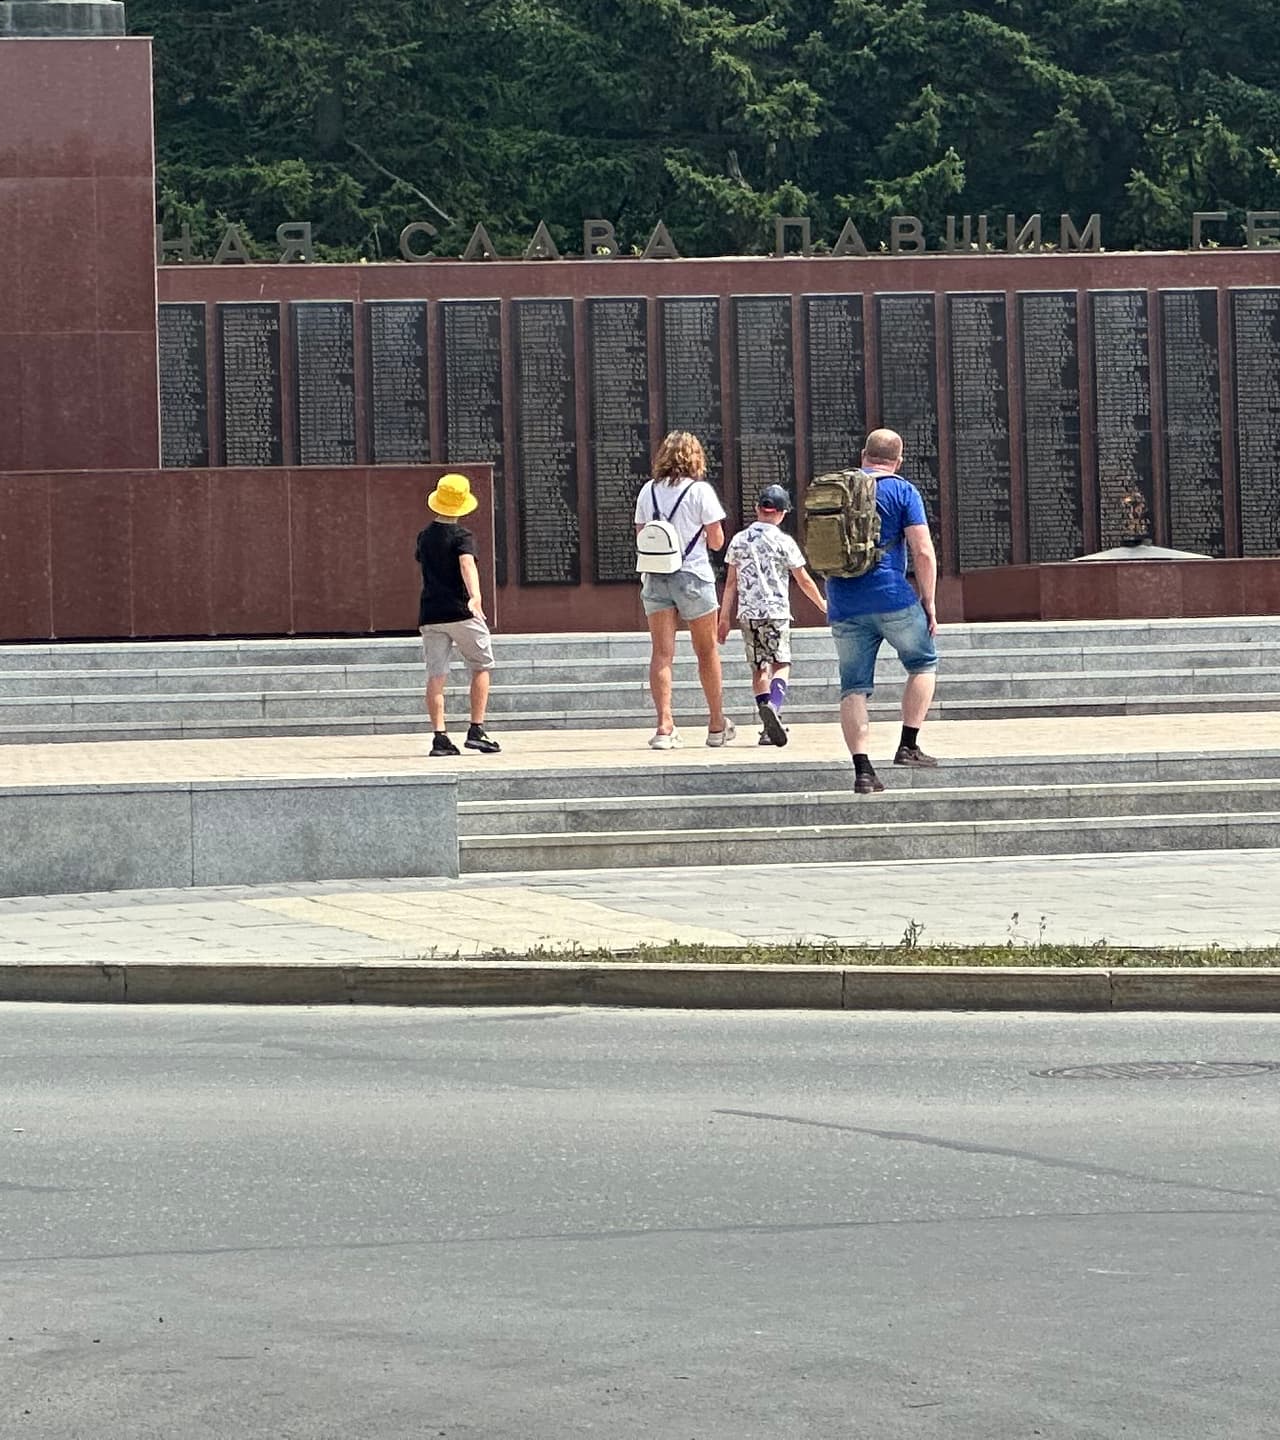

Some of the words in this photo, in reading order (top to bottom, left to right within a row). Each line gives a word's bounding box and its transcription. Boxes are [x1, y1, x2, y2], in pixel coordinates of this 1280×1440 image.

[156, 221, 314, 265] НАЯ
[400, 218, 681, 262] СЛАВА
[775, 214, 1102, 258] ПАВШИМ
